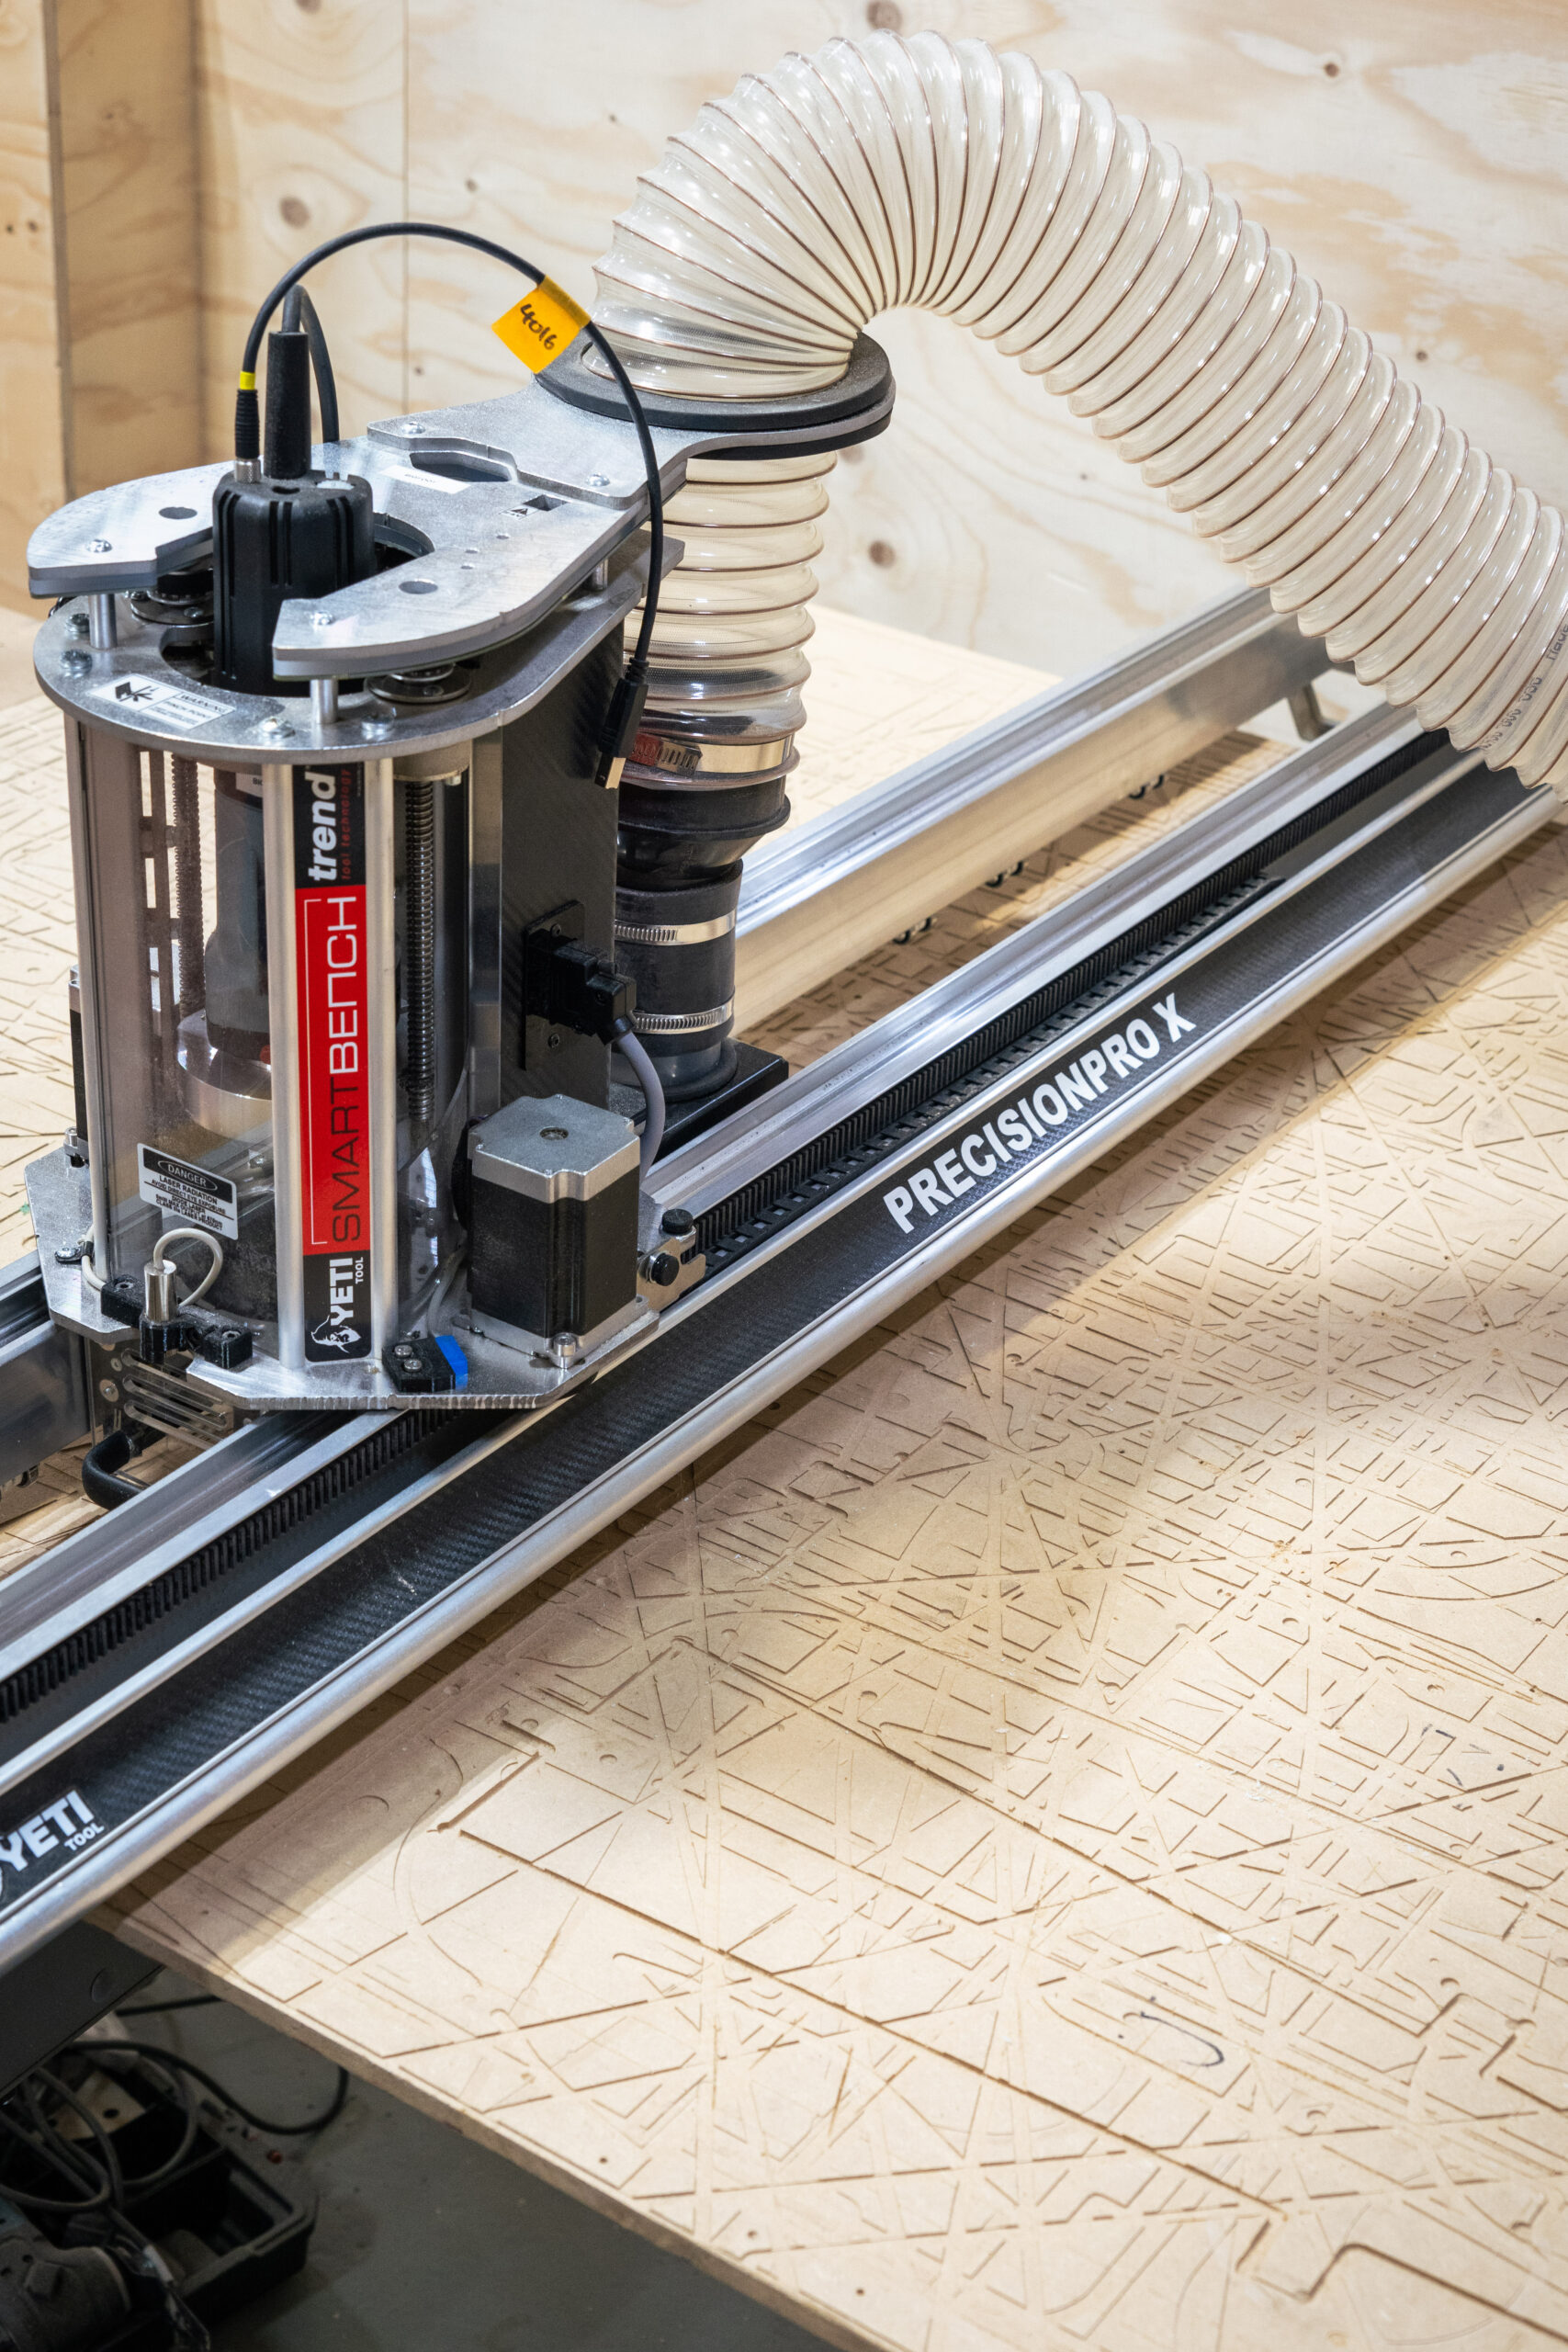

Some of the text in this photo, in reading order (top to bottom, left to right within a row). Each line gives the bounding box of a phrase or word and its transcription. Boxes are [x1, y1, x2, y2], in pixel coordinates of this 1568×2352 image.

[520, 303, 558, 351] 4016
[304, 771, 337, 881] trend
[341, 770, 352, 880] tool technology
[883, 992, 1196, 1234] PRECISIONPRO X
[151, 1179, 166, 1189] AVOID
[167, 1185, 186, 1197] DIRECT
[159, 1175, 217, 1204] LASER RADIATION
[167, 1163, 206, 1187] DANGER
[330, 1258, 354, 1327] YETI
[355, 1257, 364, 1284] TOOL
[0, 1790, 94, 1872] YETI
[63, 1823, 105, 1851] TOOL
